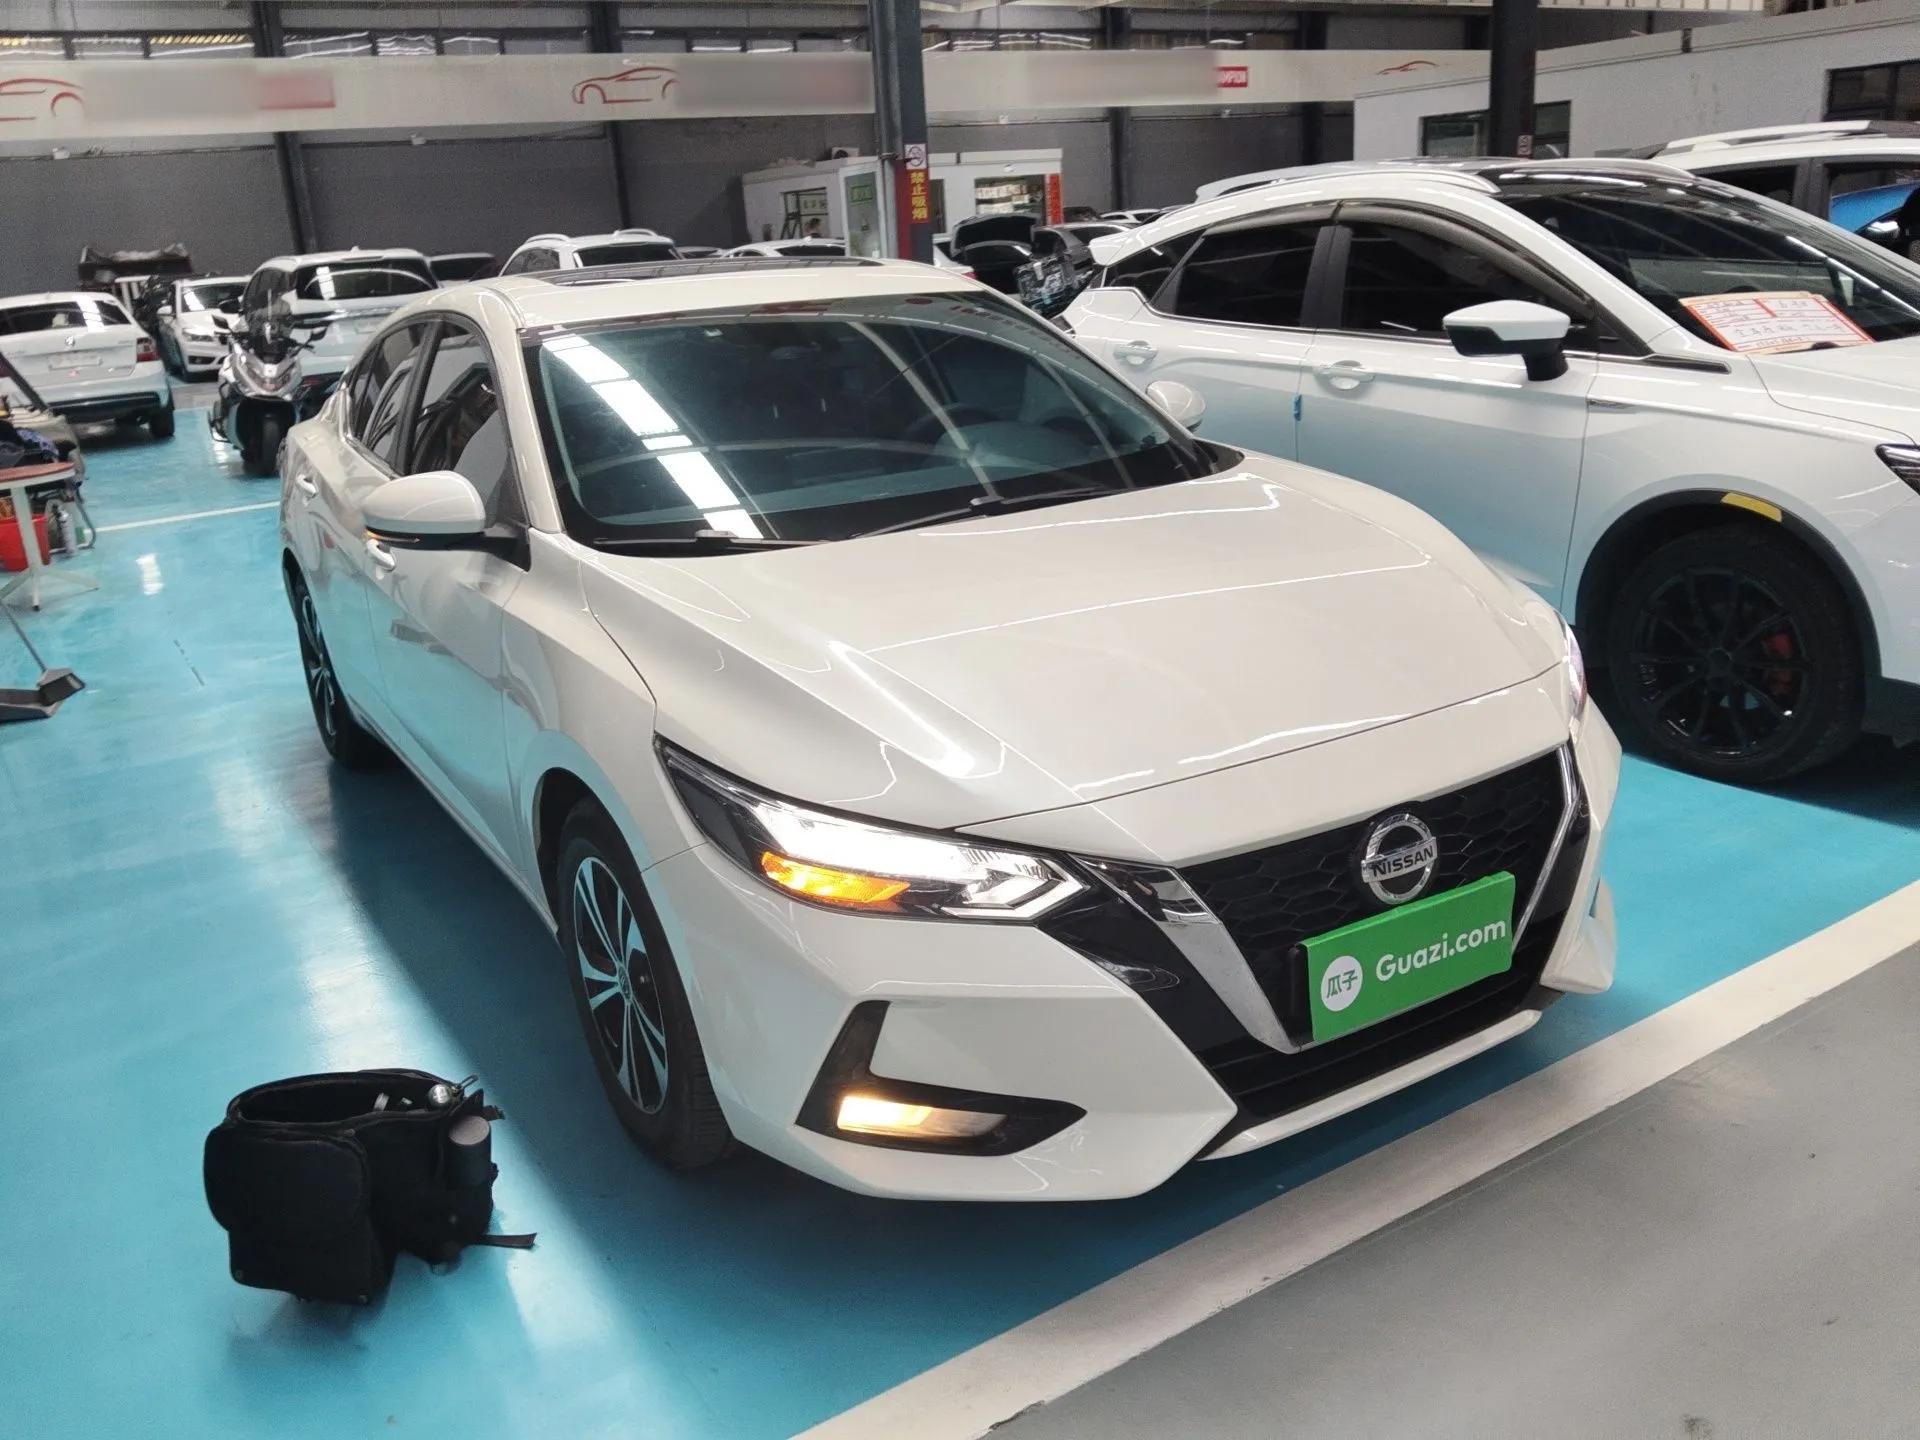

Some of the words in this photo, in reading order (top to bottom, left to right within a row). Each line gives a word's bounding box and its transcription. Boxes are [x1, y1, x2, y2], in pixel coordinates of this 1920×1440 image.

[1371, 847, 1434, 877] NISSAN
[1376, 921, 1506, 981] Guazi.com
[1326, 969, 1358, 999] 瓜子
